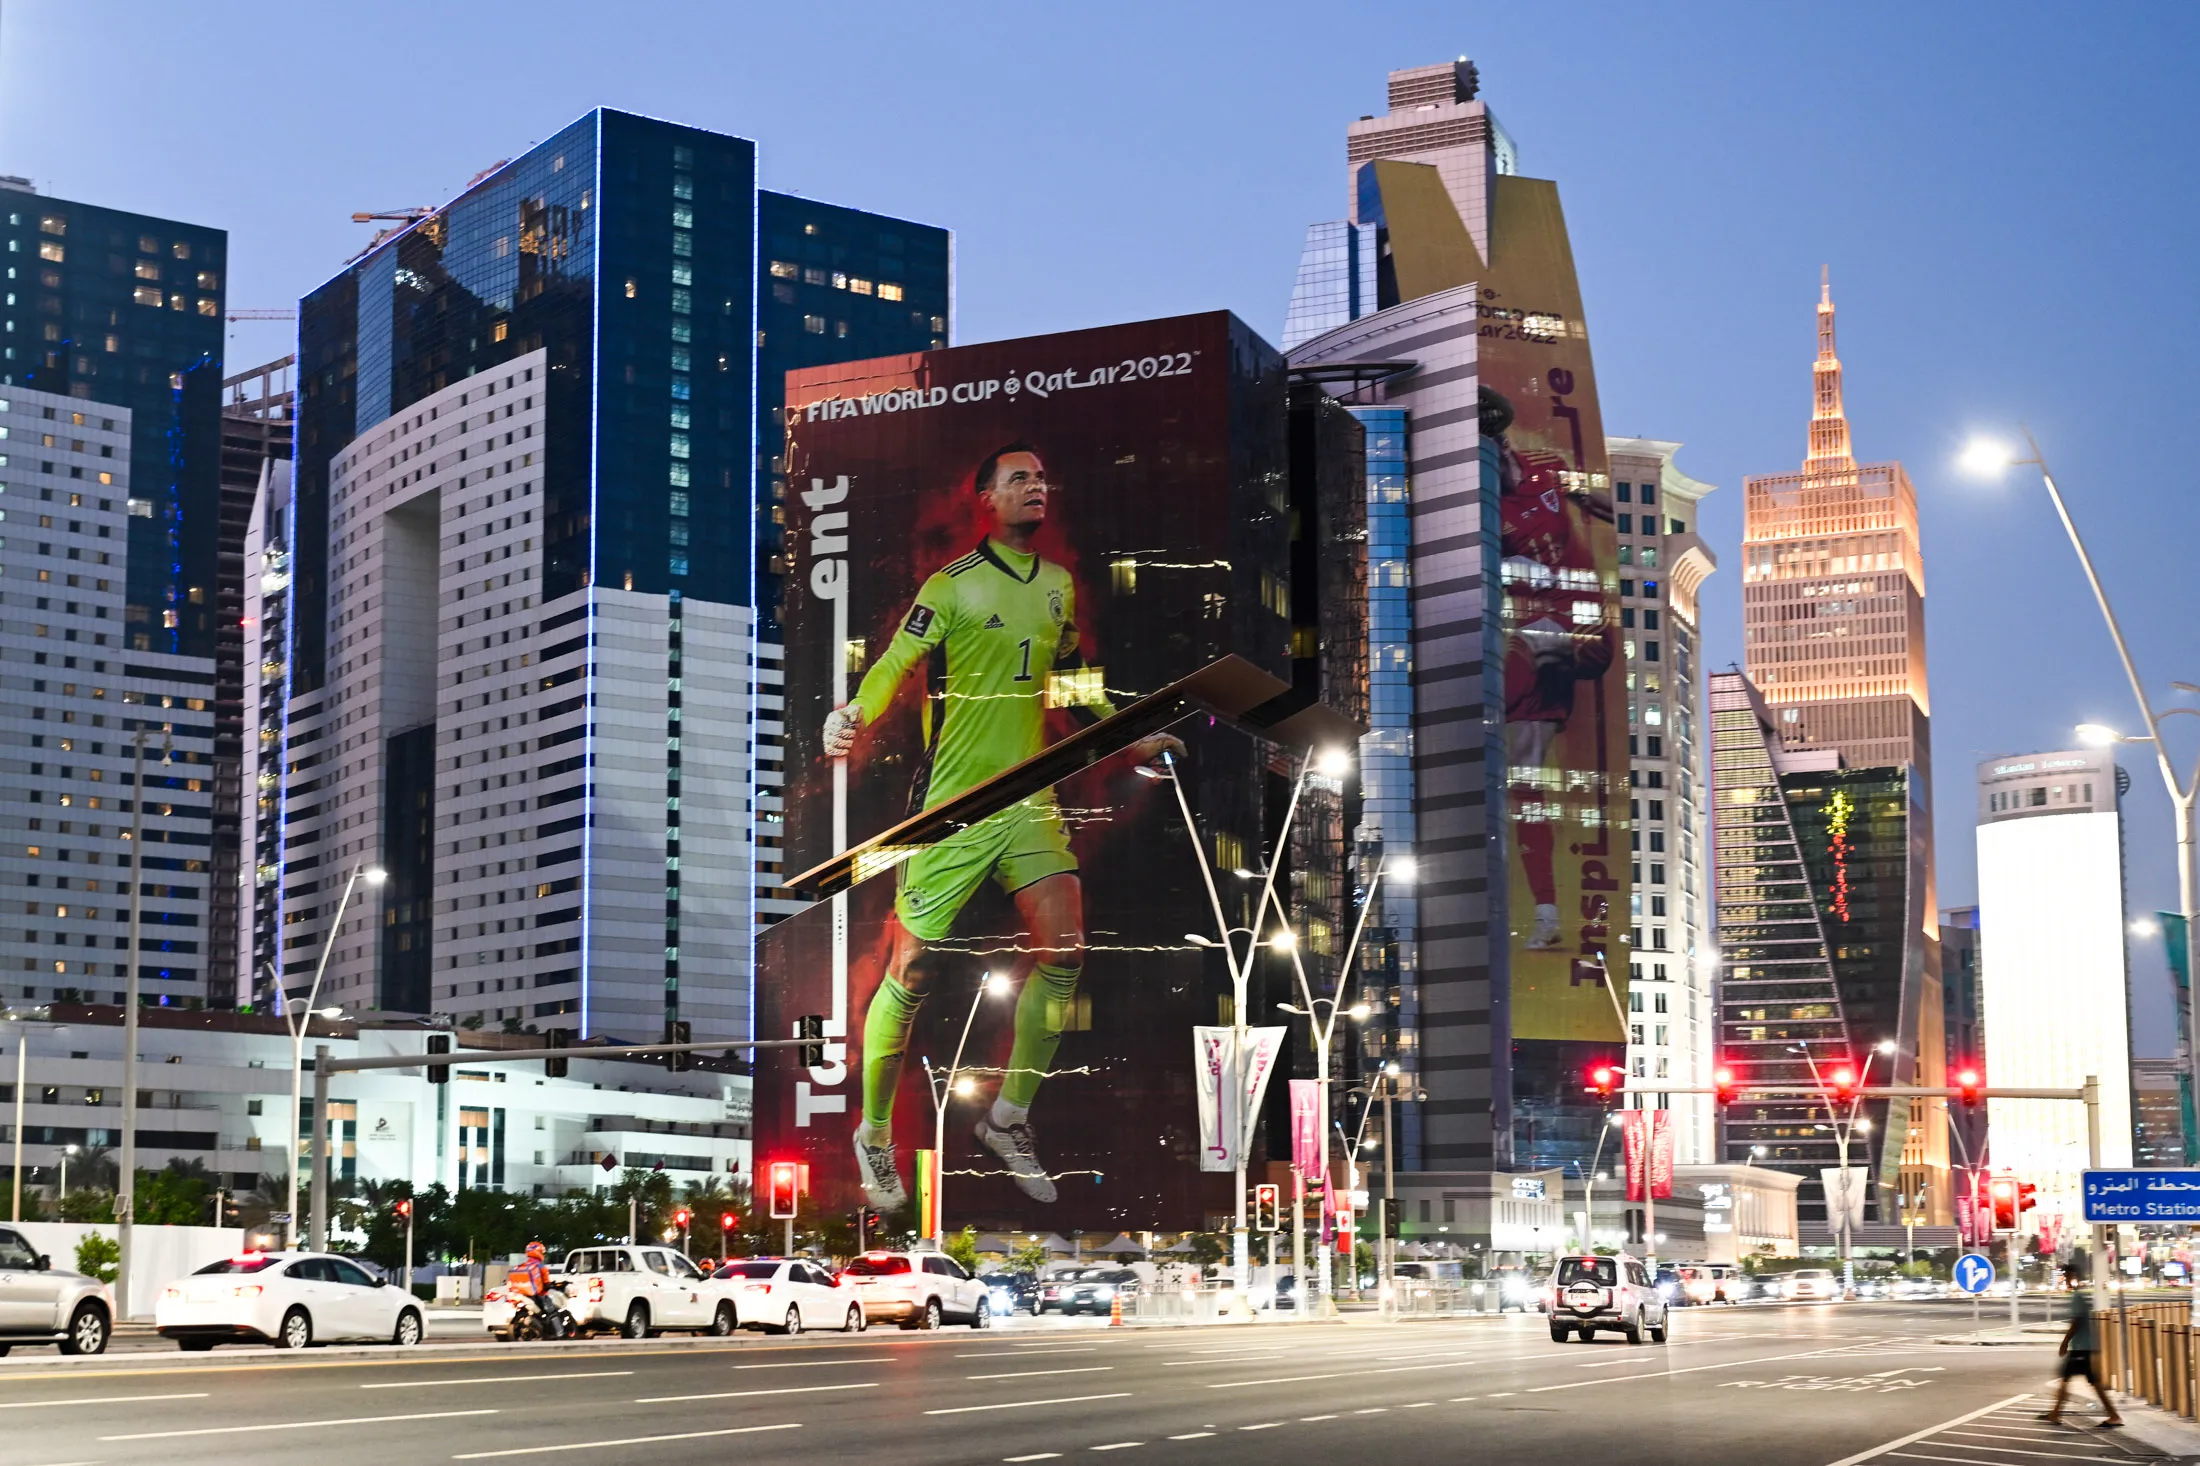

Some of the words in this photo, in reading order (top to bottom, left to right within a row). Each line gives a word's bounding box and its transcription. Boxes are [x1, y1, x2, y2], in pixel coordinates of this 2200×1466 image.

[807, 399, 858, 423] FIFA
[861, 386, 948, 415] WORLD
[952, 379, 1000, 403] CUP
[1014, 638, 1033, 682] 1
[2088, 1177, 2139, 1196] المترو
[2091, 1203, 2141, 1215] Metro
[1776, 1375, 1940, 1386] TURN
